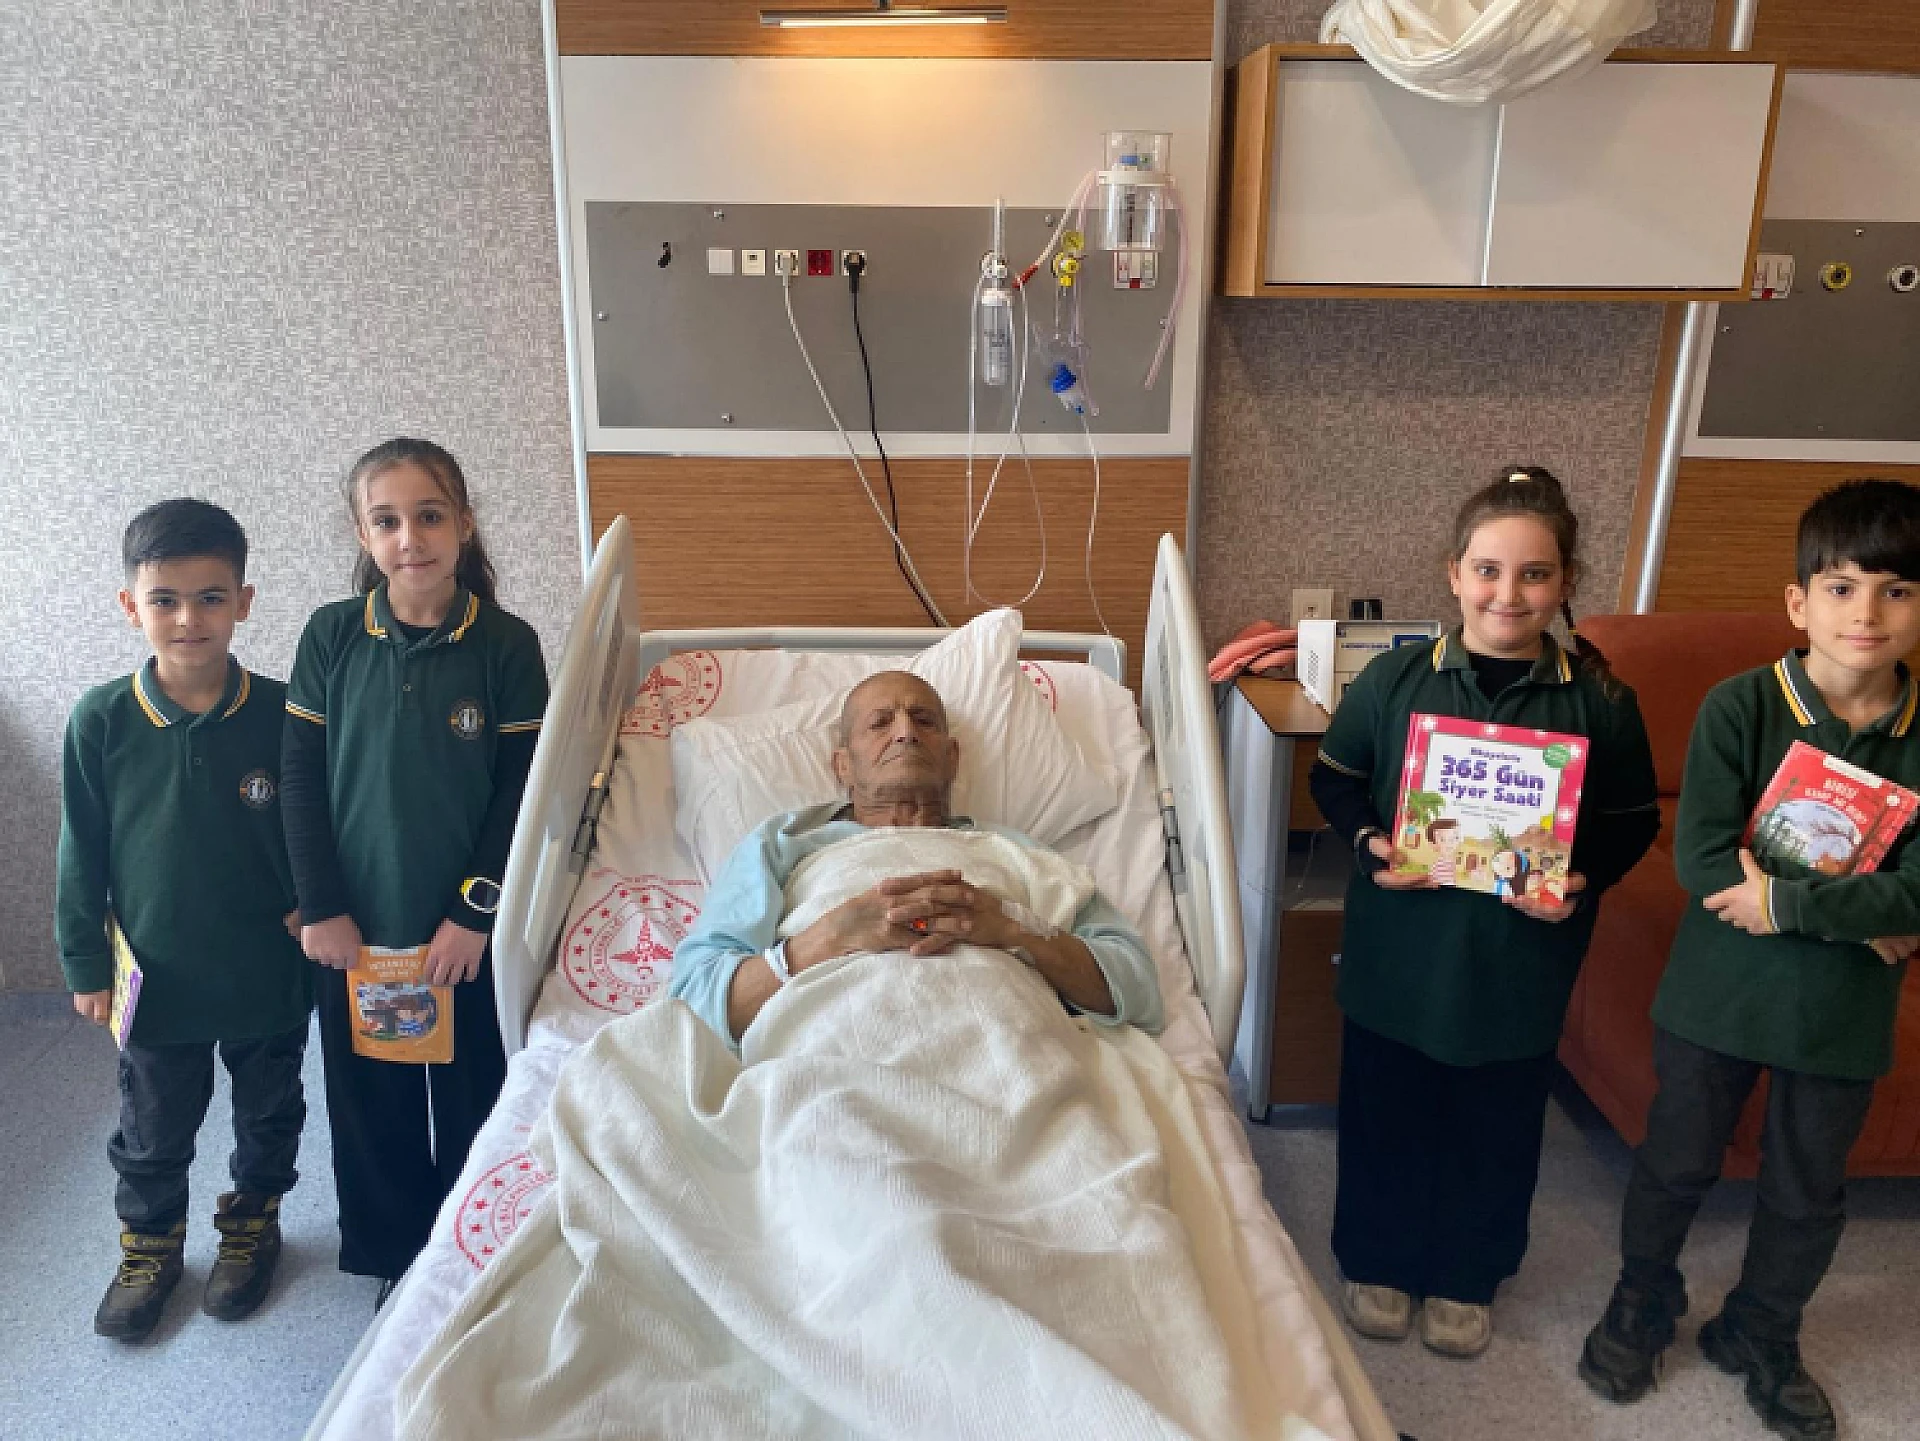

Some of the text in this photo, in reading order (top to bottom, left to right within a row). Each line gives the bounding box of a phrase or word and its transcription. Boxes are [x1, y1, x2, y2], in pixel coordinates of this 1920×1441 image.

[1440, 754, 1546, 791] 365 Gün
[1439, 777, 1489, 799] Siyer
[1493, 787, 1541, 808] Saati
